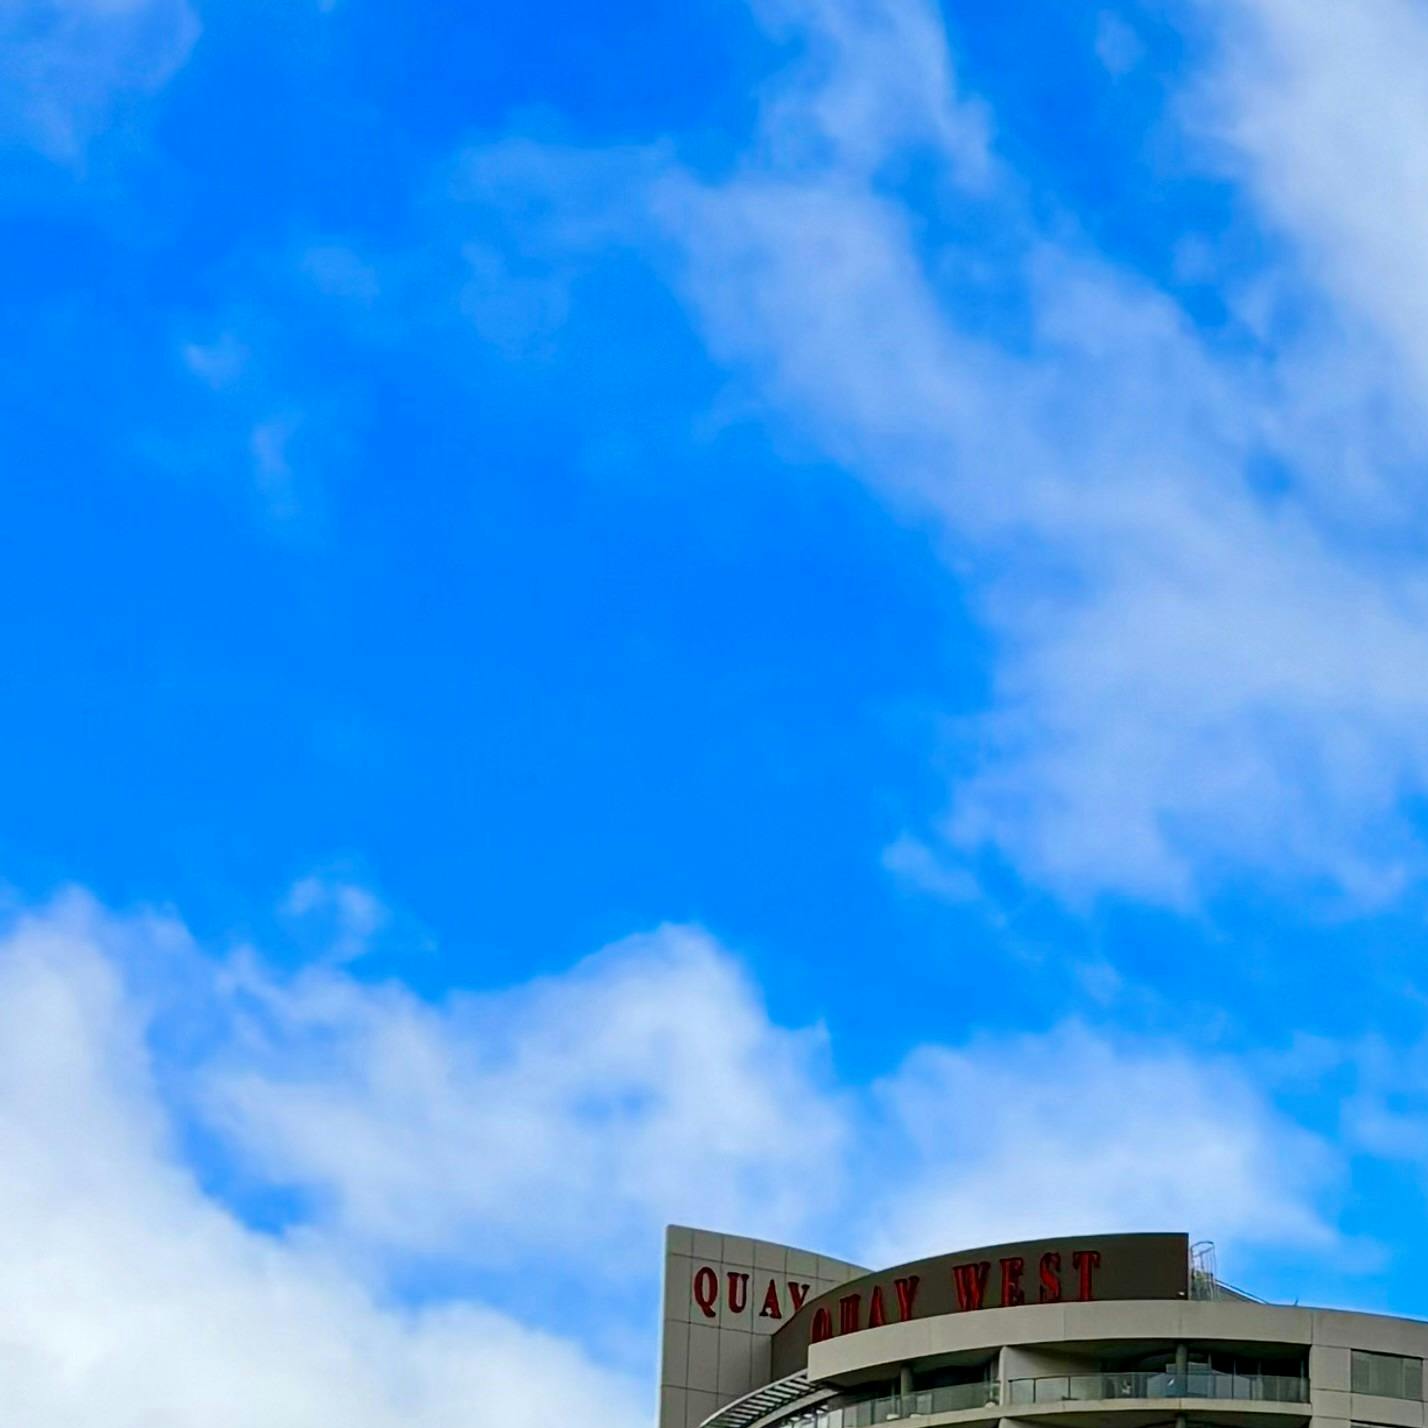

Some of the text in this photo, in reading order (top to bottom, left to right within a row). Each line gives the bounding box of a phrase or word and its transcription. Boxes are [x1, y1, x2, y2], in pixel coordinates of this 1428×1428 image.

[693, 1266, 810, 1318] QUAY
[811, 1250, 1101, 1344] QUAY WEST
